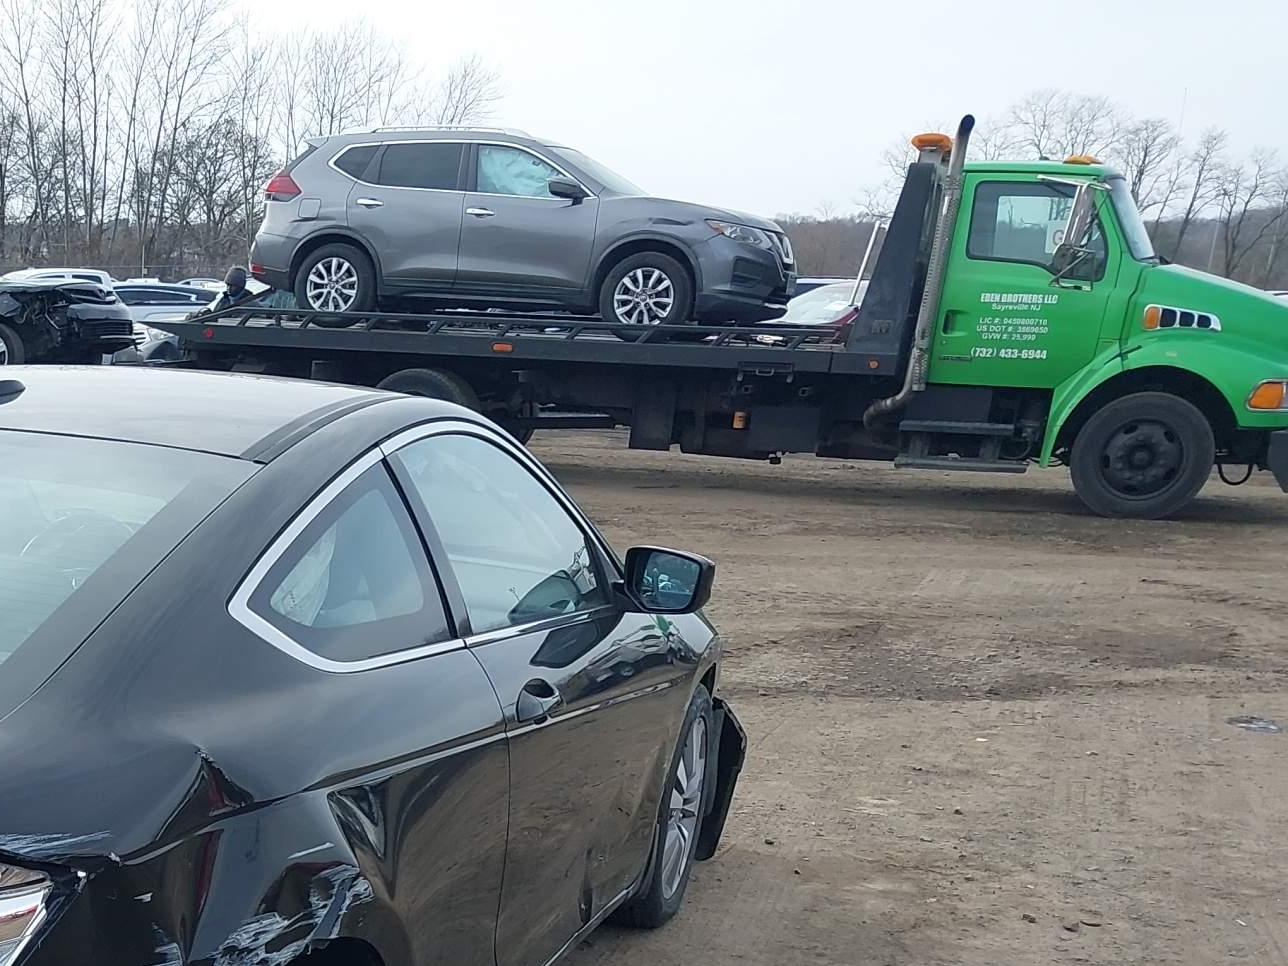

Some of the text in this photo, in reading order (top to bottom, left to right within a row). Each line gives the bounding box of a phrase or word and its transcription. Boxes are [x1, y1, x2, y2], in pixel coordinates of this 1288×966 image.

[1001, 293, 1044, 304] BROTHERS
[1044, 294, 1059, 304] LLC
[991, 303, 1029, 312] Sayreville
[981, 332, 1002, 340] GVW
[970, 347, 1048, 359] (732) 433-6944
